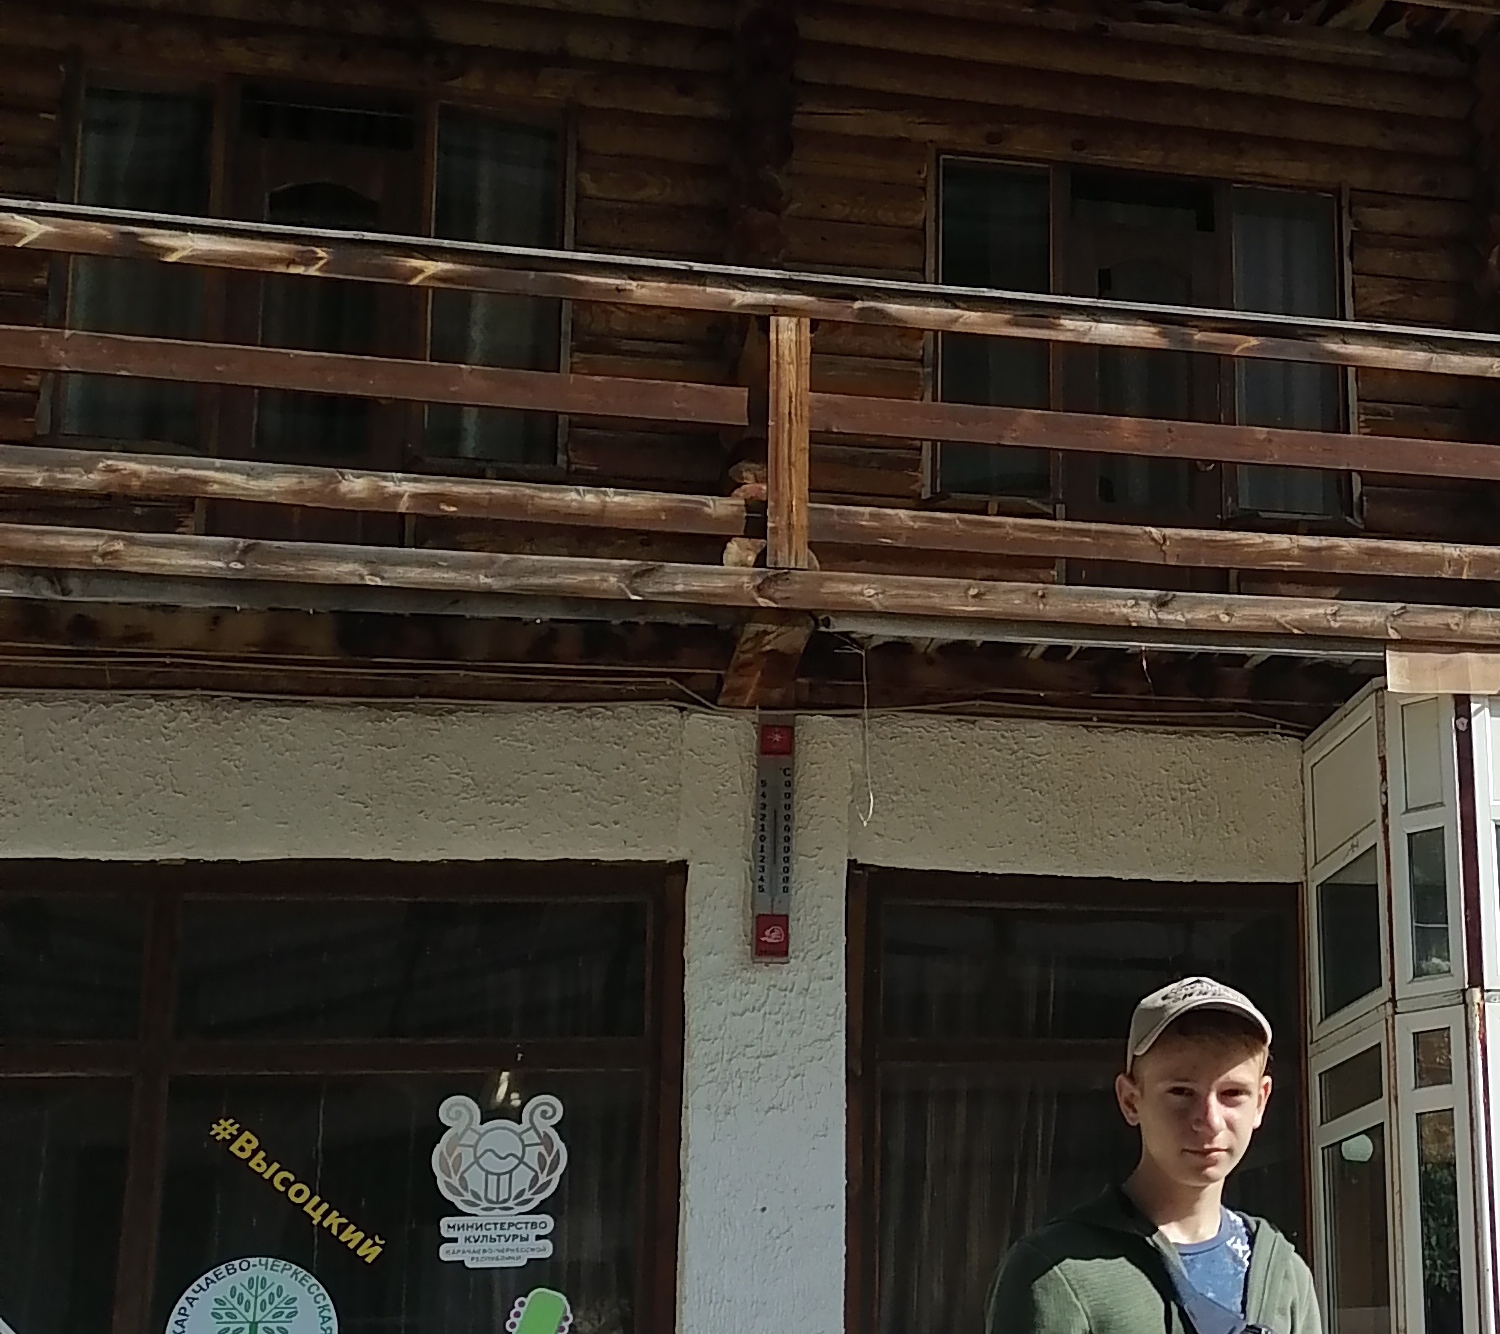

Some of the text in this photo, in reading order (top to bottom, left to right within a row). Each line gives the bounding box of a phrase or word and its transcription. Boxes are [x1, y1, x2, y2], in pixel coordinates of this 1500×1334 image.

[209, 1117, 386, 1264] #Высоцкий
[446, 1221, 548, 1233] МИНИСТЕРСТВО
[464, 1234, 530, 1244] КУЛЬТУРЫ
